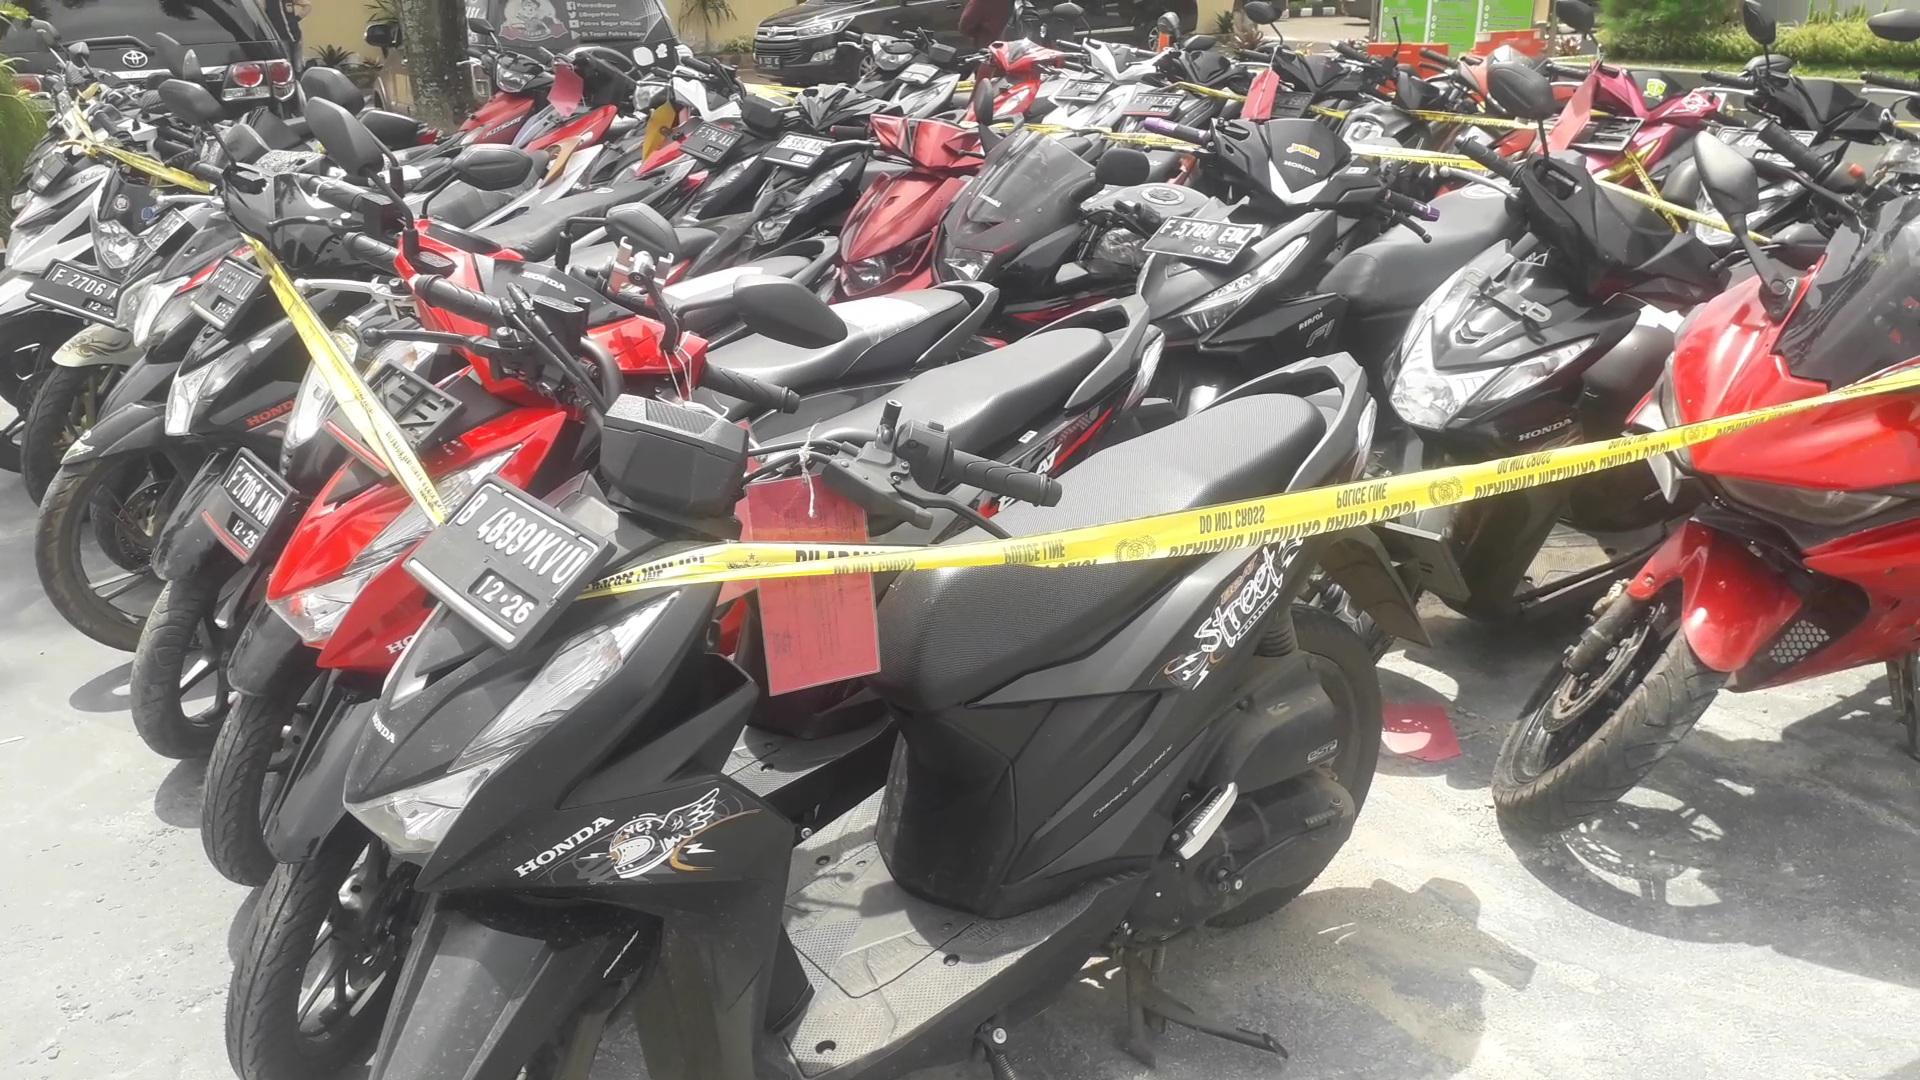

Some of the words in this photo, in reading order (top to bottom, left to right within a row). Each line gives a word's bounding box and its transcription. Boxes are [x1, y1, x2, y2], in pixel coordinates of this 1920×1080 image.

[1283, 160, 1317, 176] HONDA
[1160, 219, 1177, 234] F
[52, 268, 68, 282] F
[67, 274, 107, 297] 2706
[521, 271, 567, 292] HONDA
[1518, 417, 1573, 442] HONDA
[225, 465, 244, 488] F
[232, 472, 262, 508] 2706
[455, 492, 489, 526] B
[477, 507, 538, 555] 4899
[522, 532, 589, 584] KVU
[1194, 546, 1284, 653] Street
[624, 818, 653, 836] YES
[513, 816, 616, 878] HONDA
